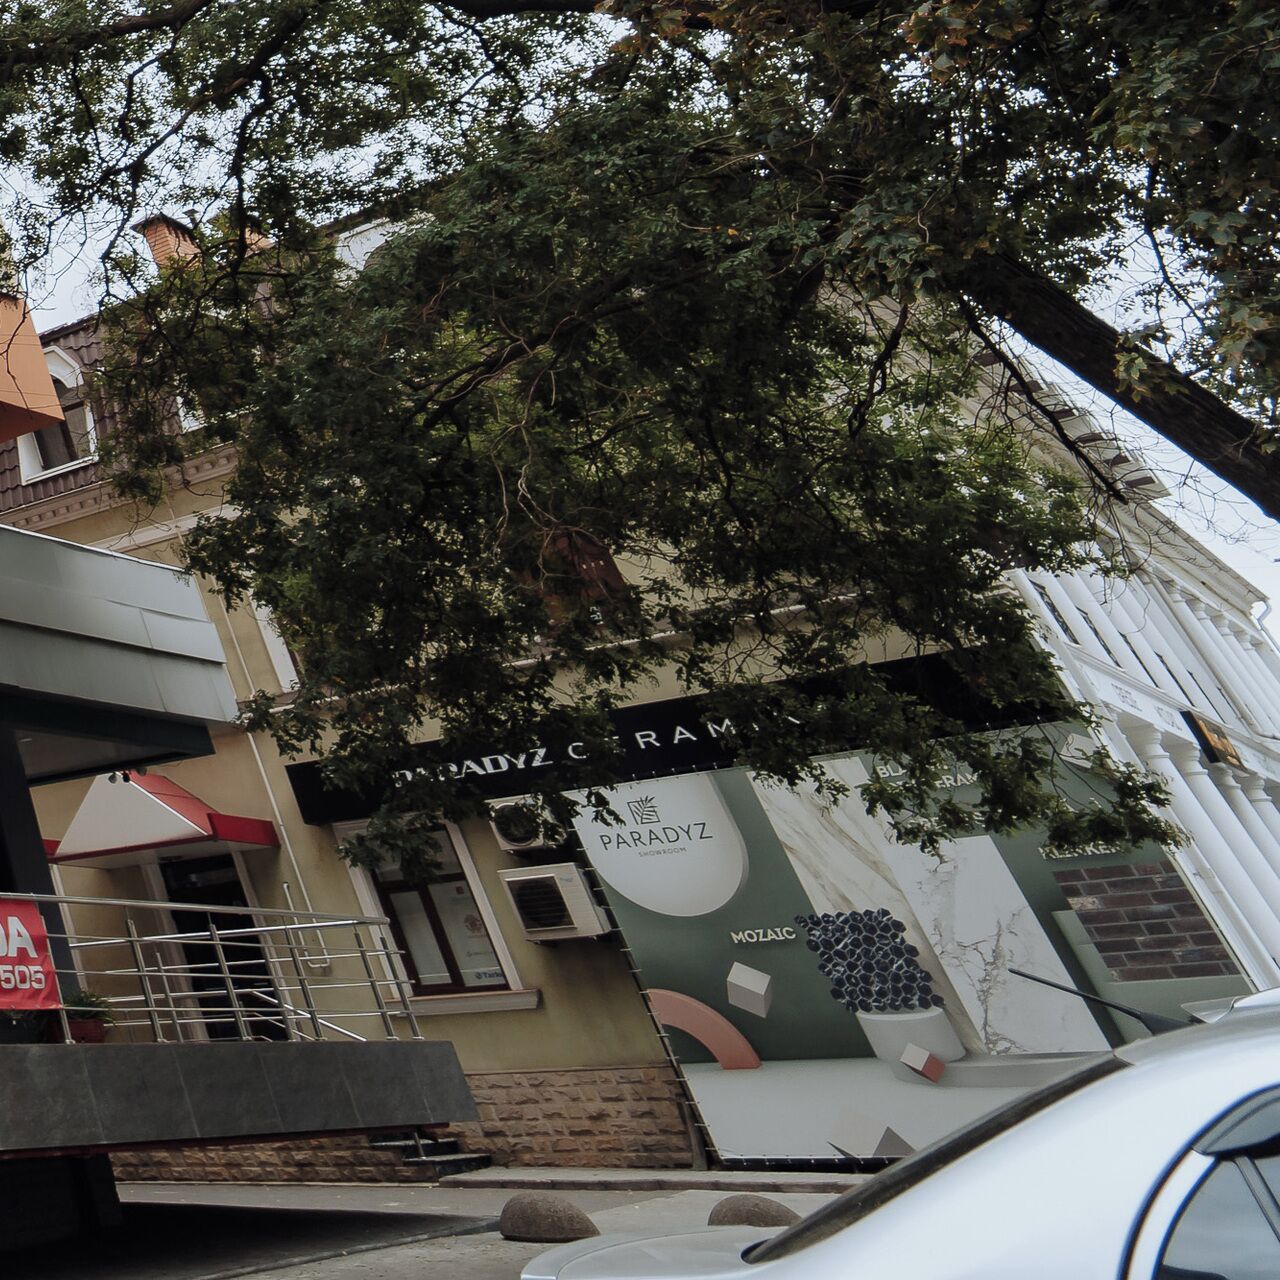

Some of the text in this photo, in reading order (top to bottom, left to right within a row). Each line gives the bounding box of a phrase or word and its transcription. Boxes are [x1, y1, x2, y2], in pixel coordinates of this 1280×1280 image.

[599, 822, 713, 851] PARADYZ
[638, 846, 688, 858] SHOWROOM
[730, 927, 797, 944] MOZAIC
